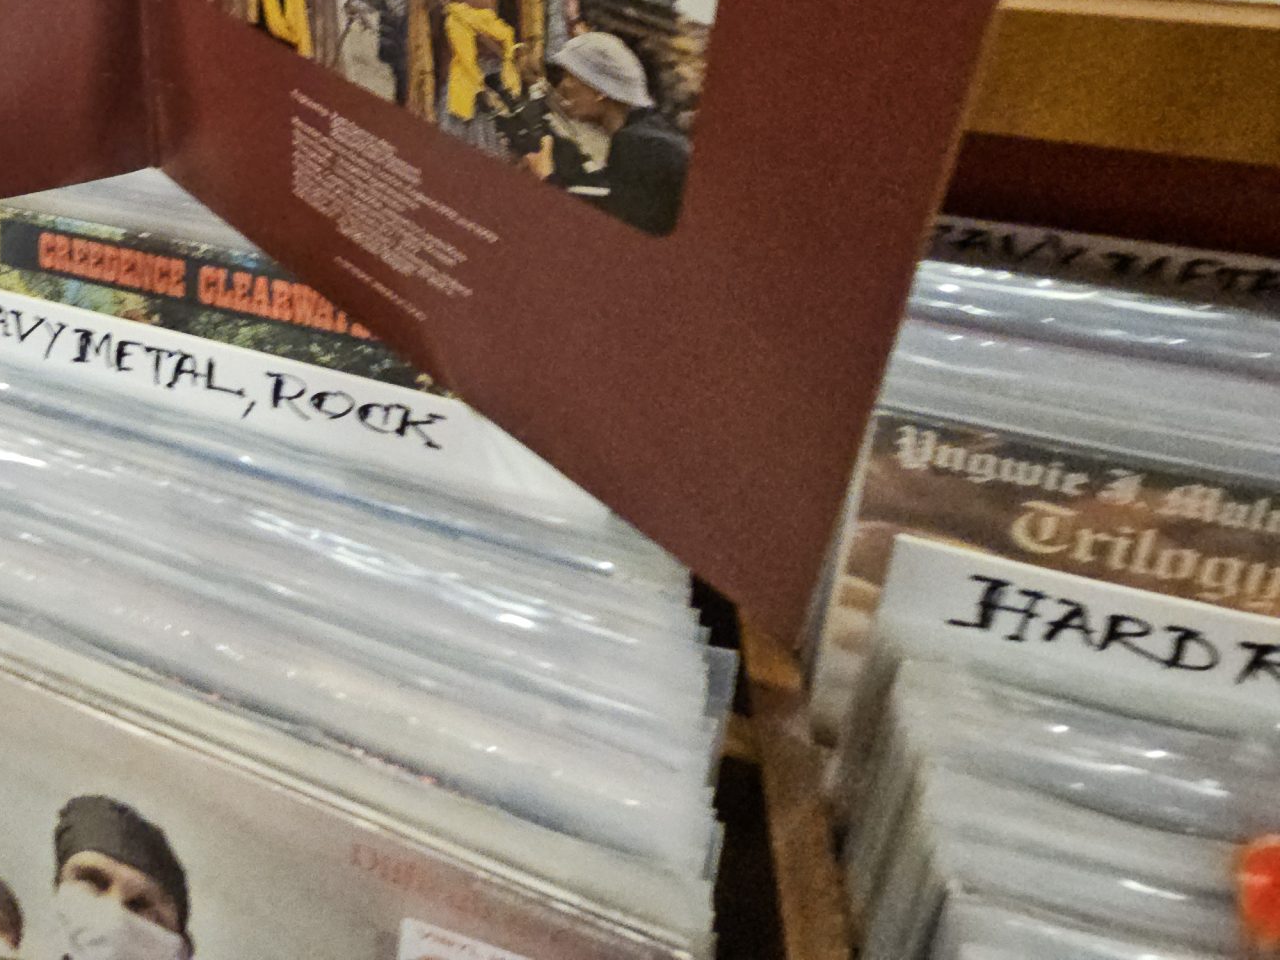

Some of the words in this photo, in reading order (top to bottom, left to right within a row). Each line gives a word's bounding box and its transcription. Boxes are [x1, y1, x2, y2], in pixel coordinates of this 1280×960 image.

[38, 231, 187, 299] CREEDENCE
[266, 371, 447, 450] ROCK
[945, 574, 1219, 672] HARD
